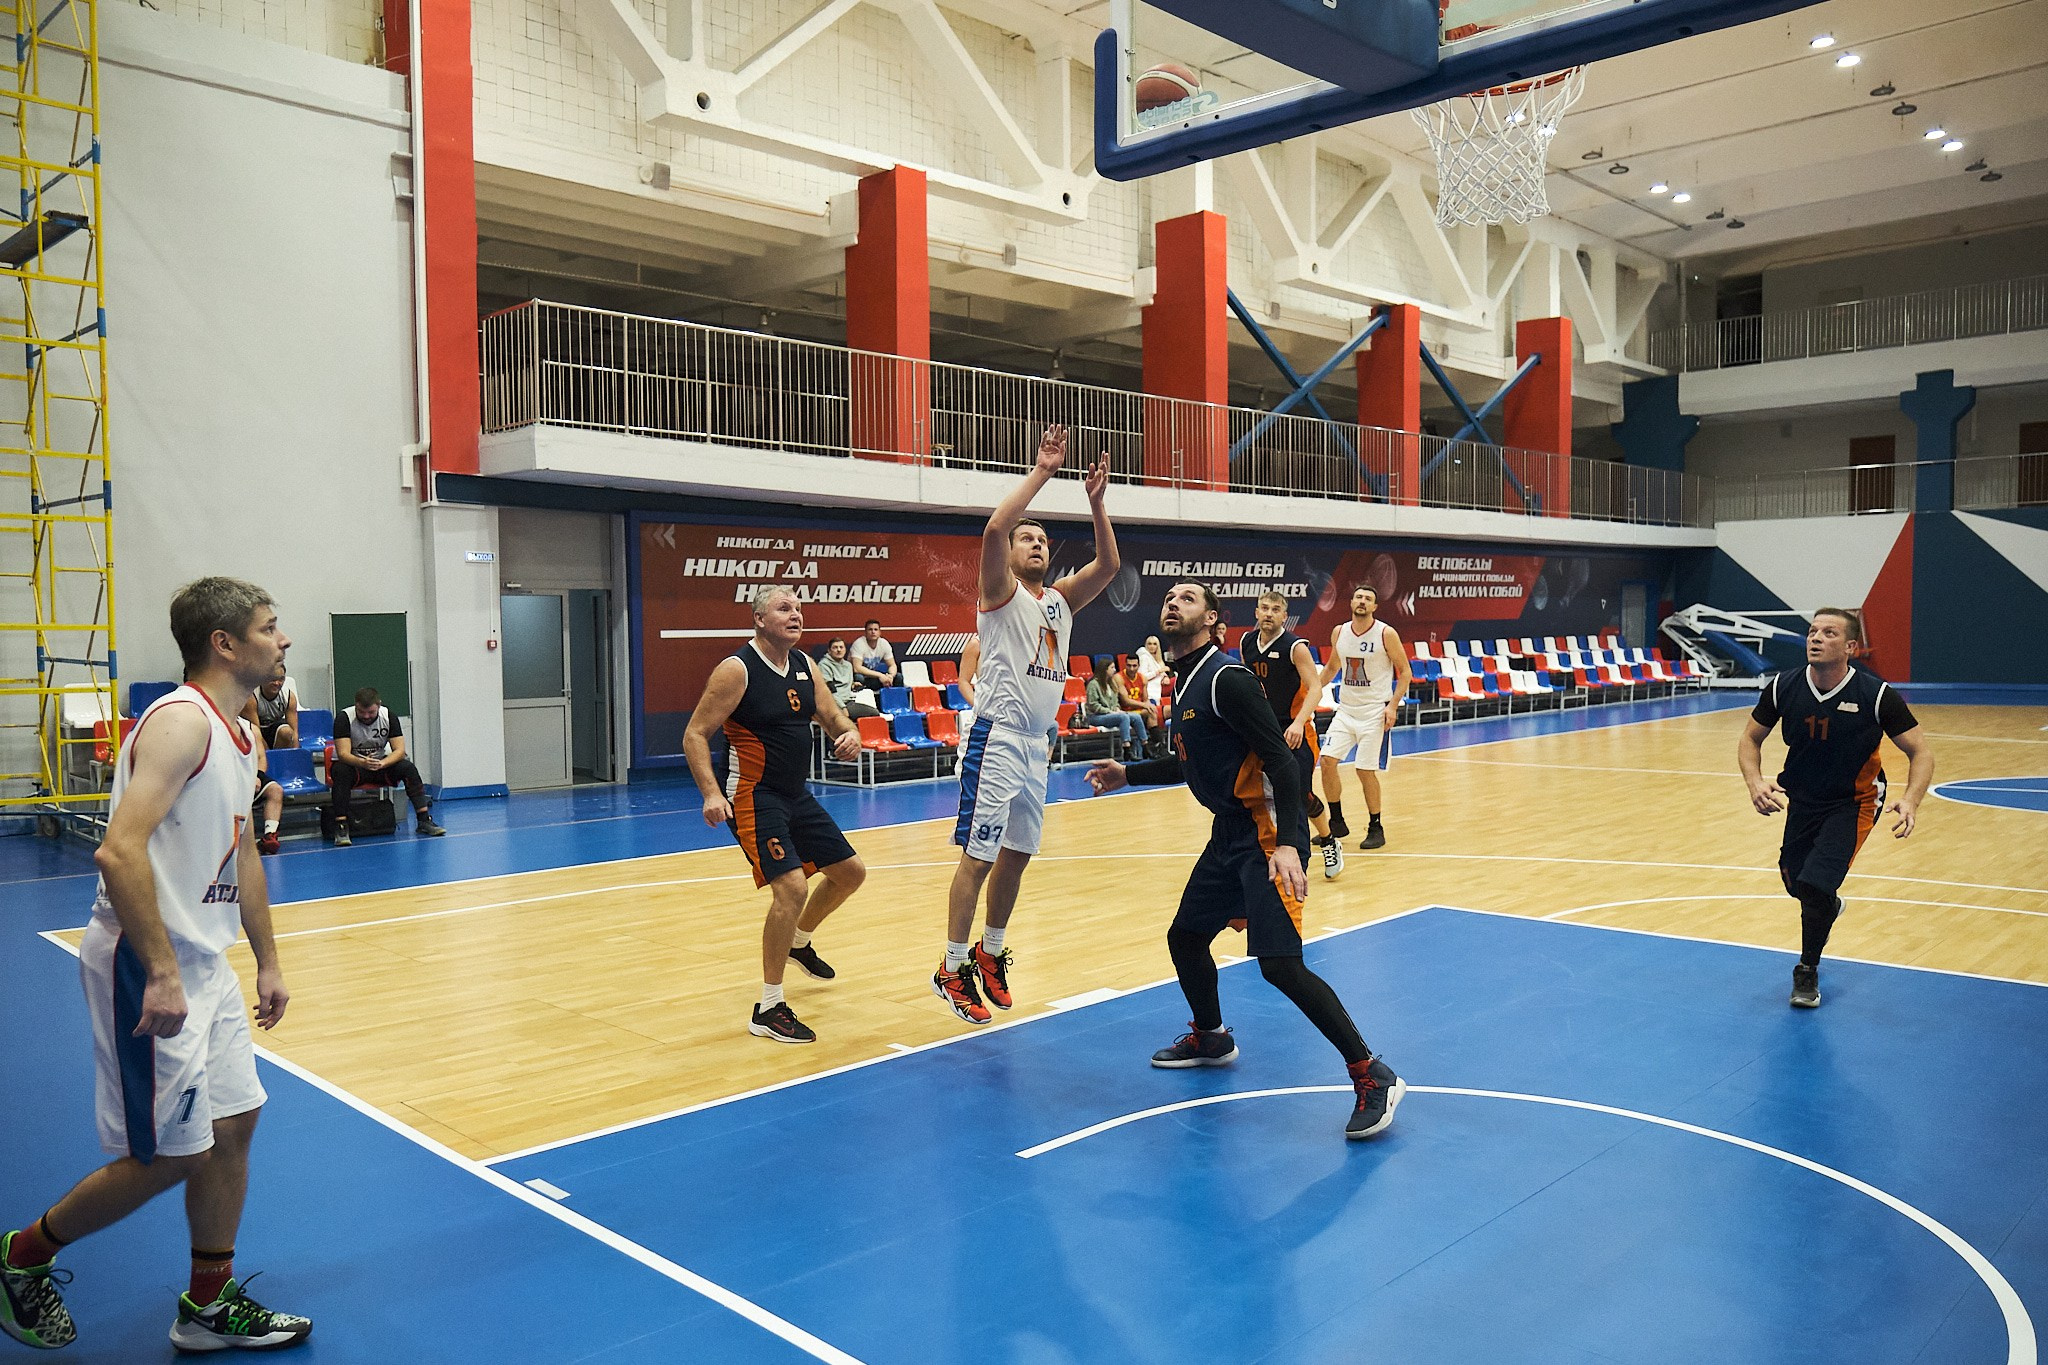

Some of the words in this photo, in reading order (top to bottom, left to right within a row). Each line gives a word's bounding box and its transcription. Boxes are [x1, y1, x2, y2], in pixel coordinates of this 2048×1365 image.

[717, 537, 795, 550] НИКОГДА
[802, 544, 889, 559] НИКОГДА
[683, 558, 818, 578] НИКОГДА
[1142, 560, 1243, 578] ПОБЕДИШЬ
[1245, 562, 1285, 578] СЕБЯ
[1418, 556, 1440, 570] ВСЕ
[1441, 557, 1492, 571] ПОБЕДЫ
[779, 580, 922, 603] ДАВАЙСЯ!
[1419, 585, 1442, 598] НАД
[1444, 585, 1487, 598] САМИМ
[1489, 583, 1523, 598] СОБОЙ
[1360, 641, 1374, 653] 31
[1252, 661, 1268, 678] 10
[787, 688, 801, 712] 6
[1182, 708, 1196, 721] АСБ
[371, 727, 389, 739] 20
[1804, 715, 1830, 740] 11
[977, 824, 1004, 843] 97
[766, 838, 785, 861] 6
[177, 1084, 198, 1125] 7
[224, 1315, 250, 1337] 34
